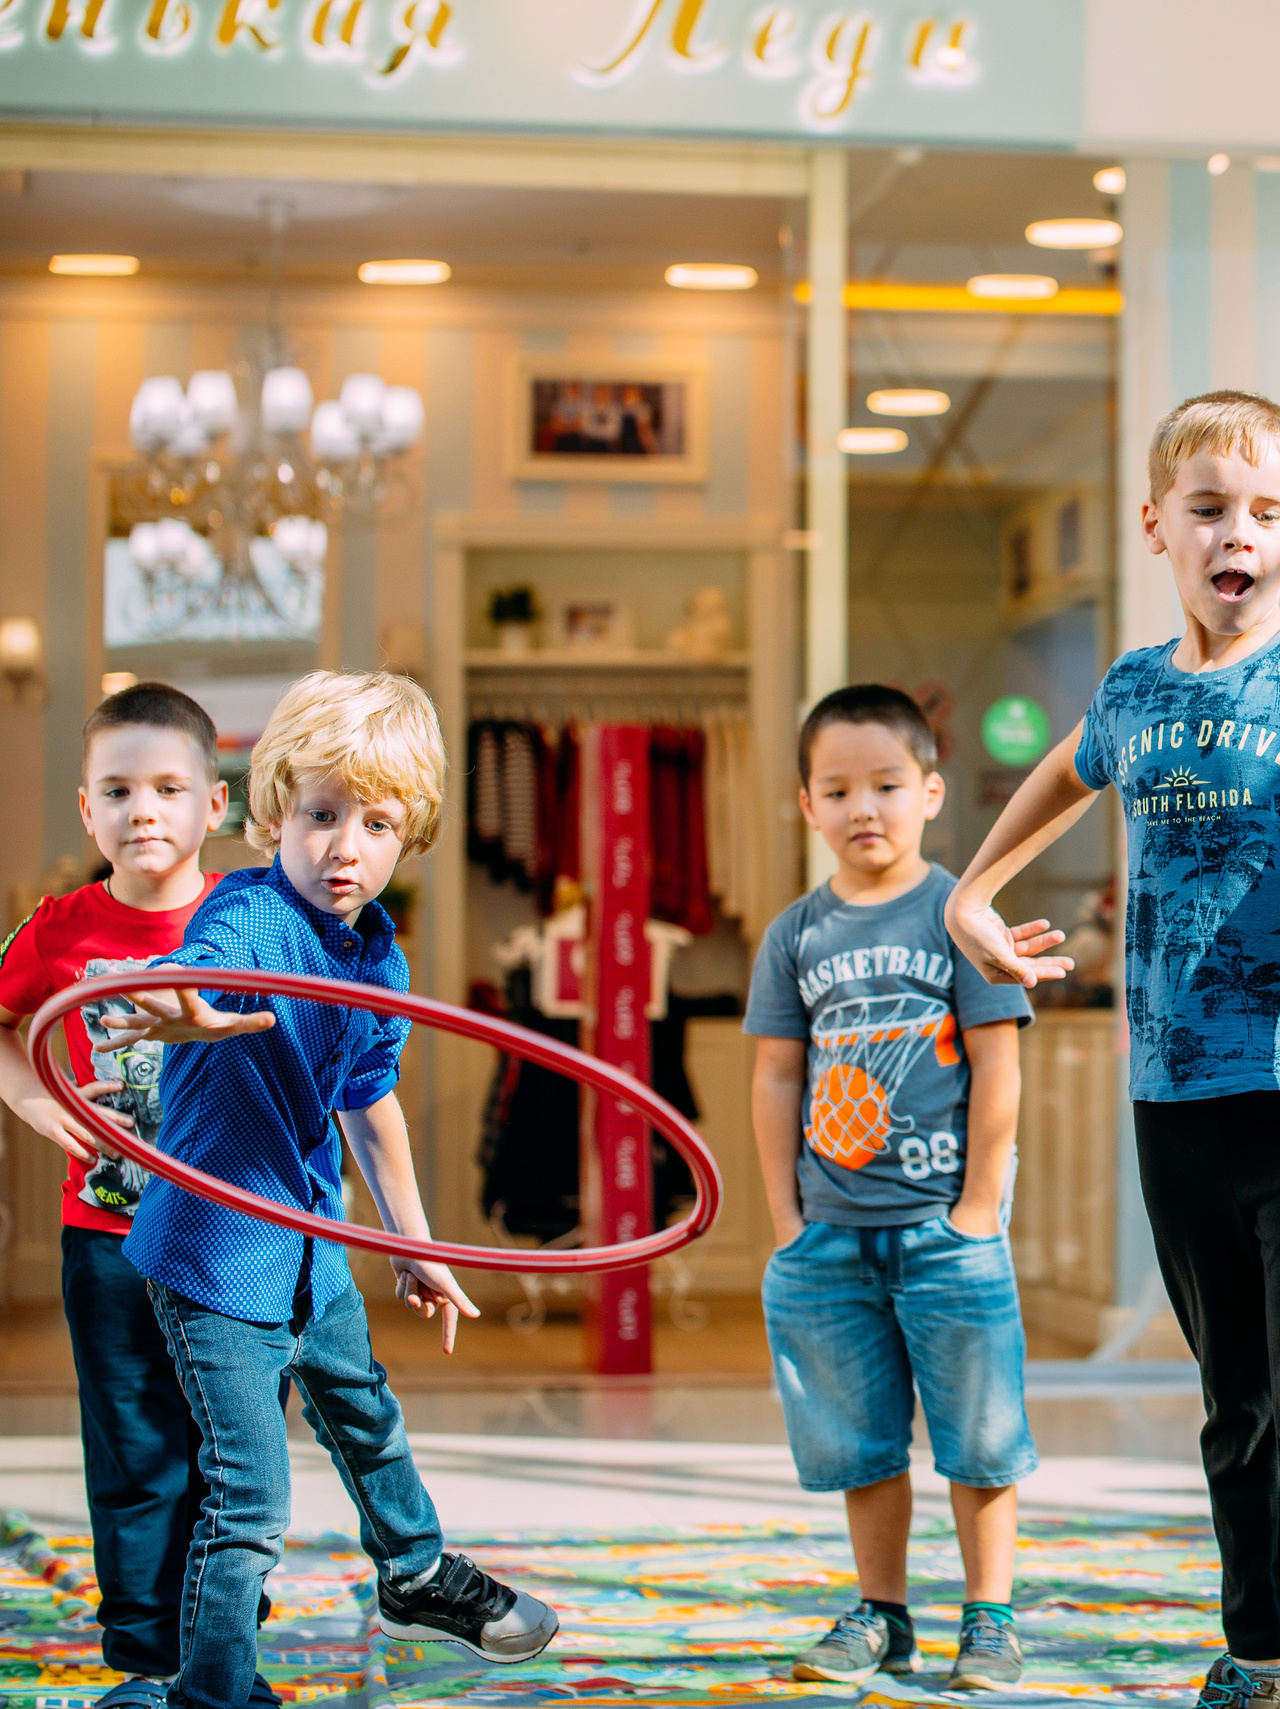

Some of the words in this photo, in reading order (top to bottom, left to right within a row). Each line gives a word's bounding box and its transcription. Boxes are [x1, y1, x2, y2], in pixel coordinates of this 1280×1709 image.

[0, 0, 456, 80] нькая
[1117, 721, 1184, 785] SCENIC
[1132, 794, 1169, 818] SOUTH
[1176, 788, 1252, 811] FLORIDA
[1198, 814, 1221, 822] BEACH
[898, 1130, 960, 1181] 88
[94, 1185, 128, 1205] BEATS
